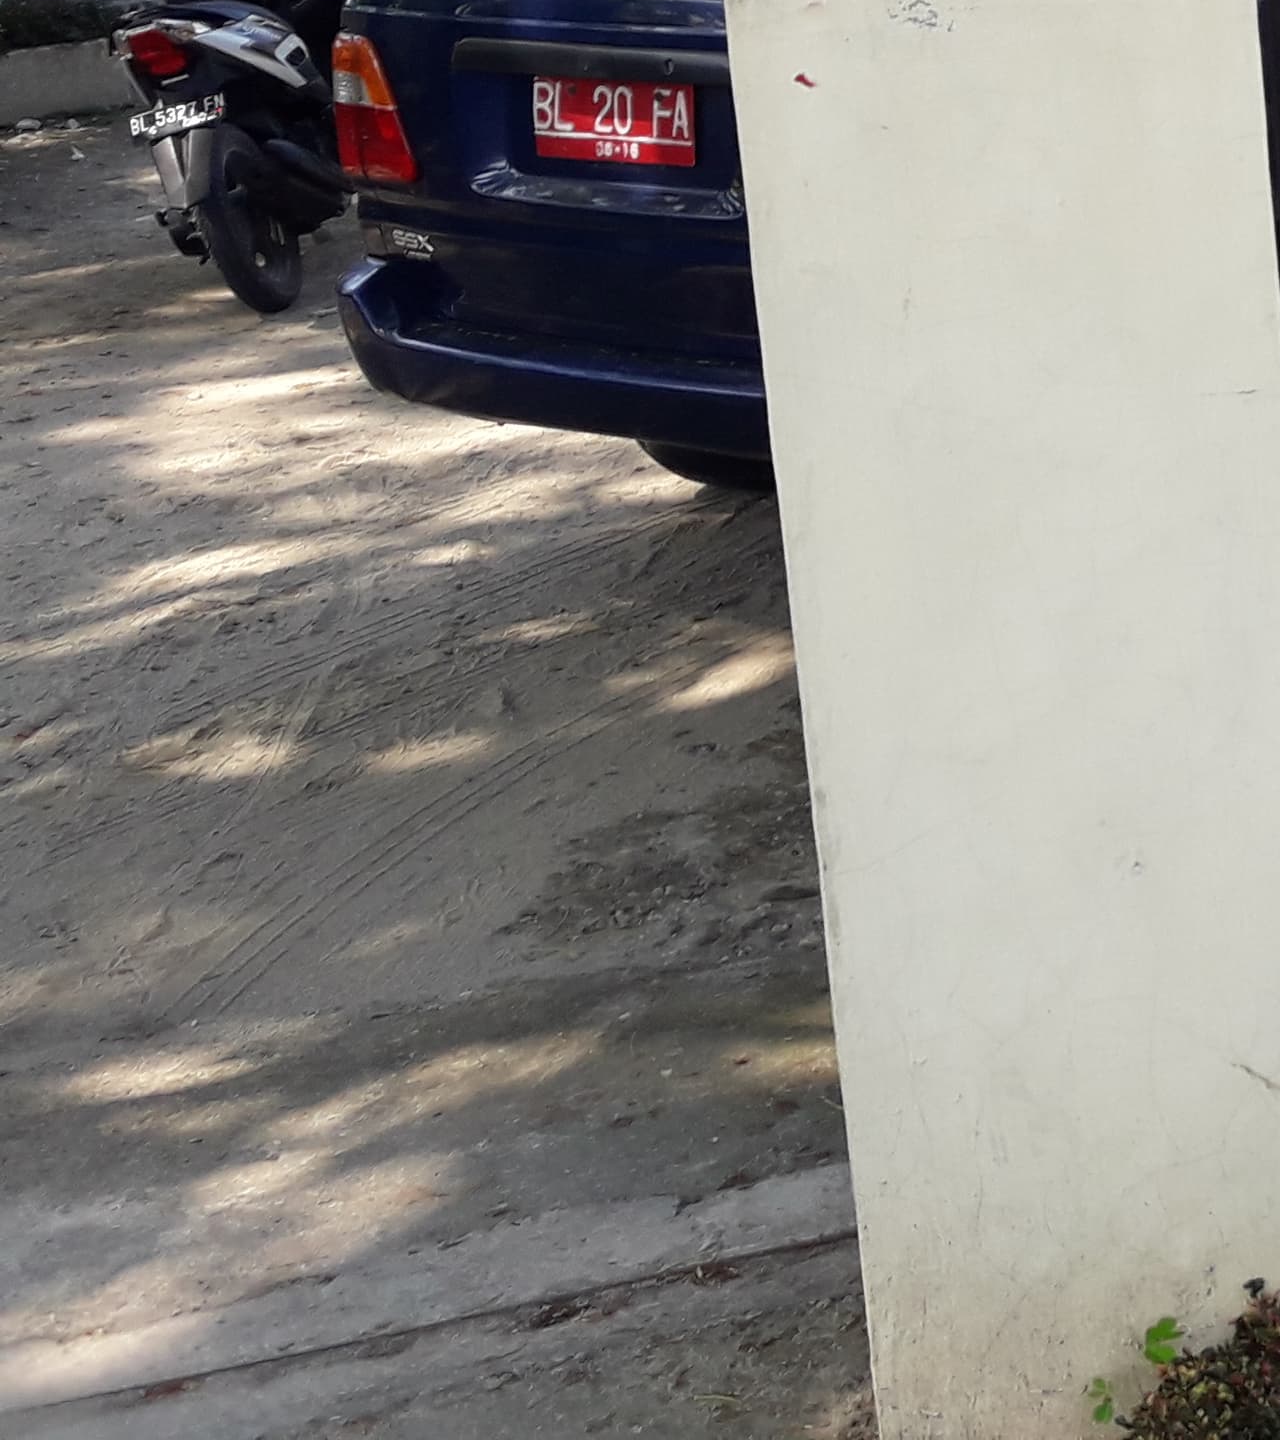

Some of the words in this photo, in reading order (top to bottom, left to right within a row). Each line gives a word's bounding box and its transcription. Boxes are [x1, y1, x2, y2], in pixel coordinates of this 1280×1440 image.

[129, 114, 149, 137] BL
[532, 81, 574, 132] BL
[592, 85, 633, 135] 20
[651, 89, 690, 139] FA
